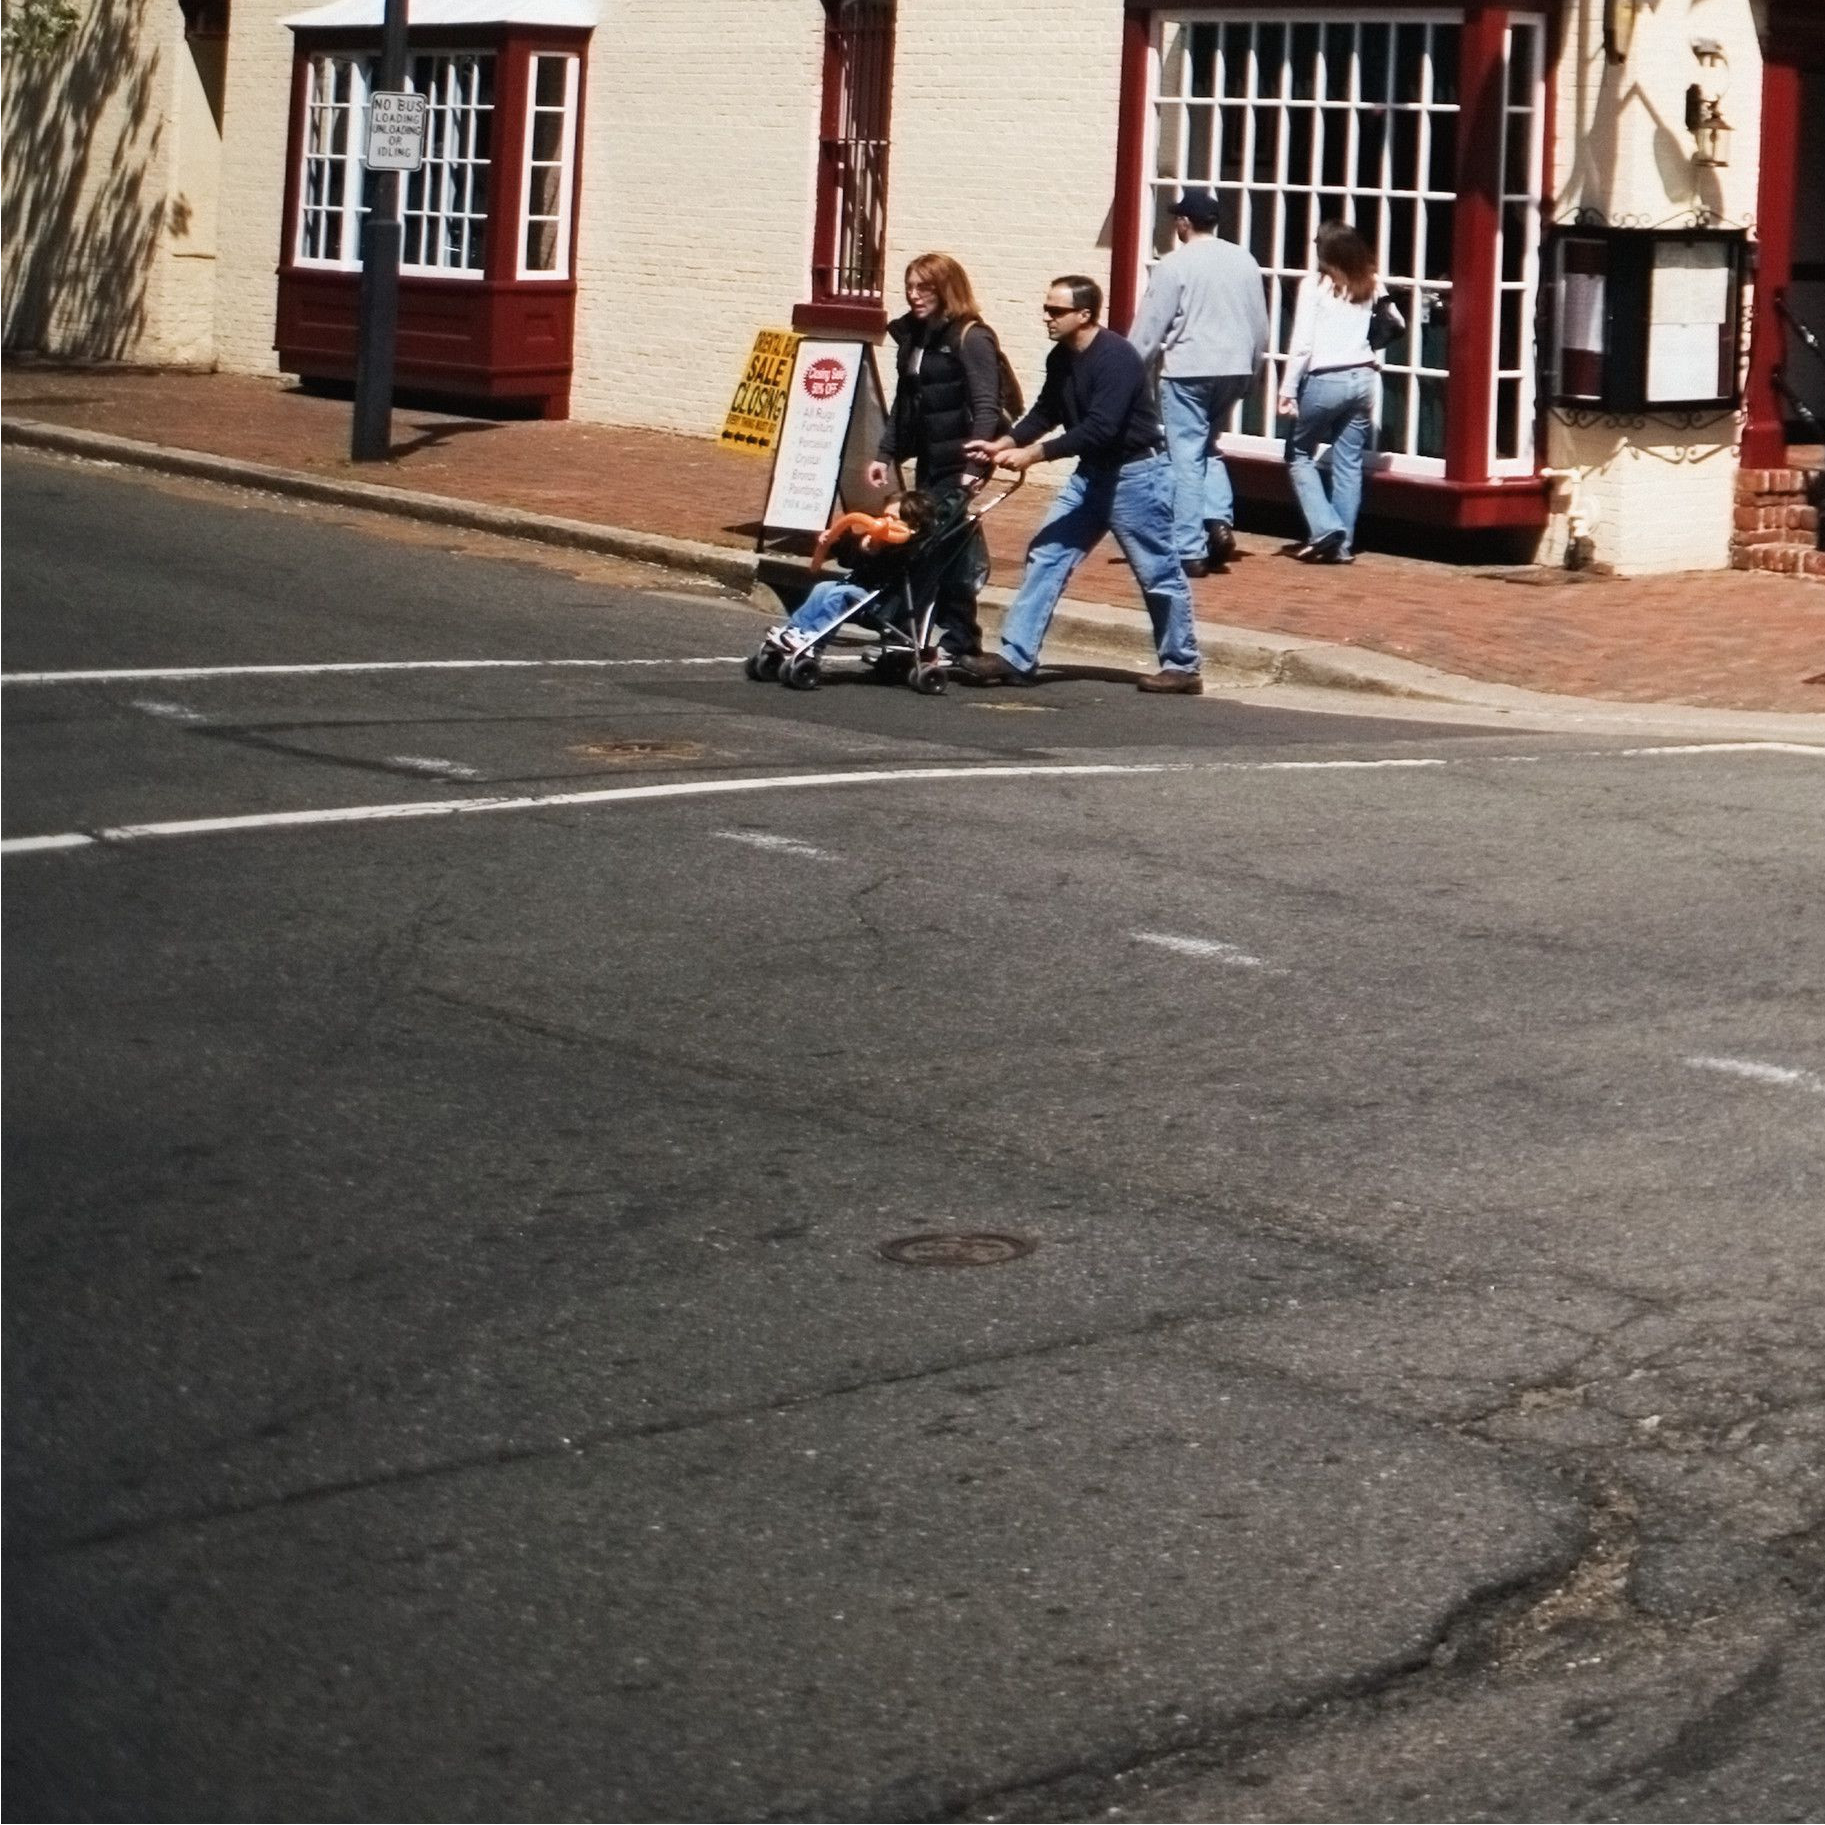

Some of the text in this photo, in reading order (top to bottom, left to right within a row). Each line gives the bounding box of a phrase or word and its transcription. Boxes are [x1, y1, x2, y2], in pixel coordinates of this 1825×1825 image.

[374, 98, 424, 113] NO BUS
[375, 113, 420, 124] LOADING
[373, 124, 423, 135] UNLOADING
[388, 136, 402, 146] OR
[377, 146, 412, 157] IDLING
[746, 354, 788, 386] SALE
[731, 381, 786, 421] CLOSING
